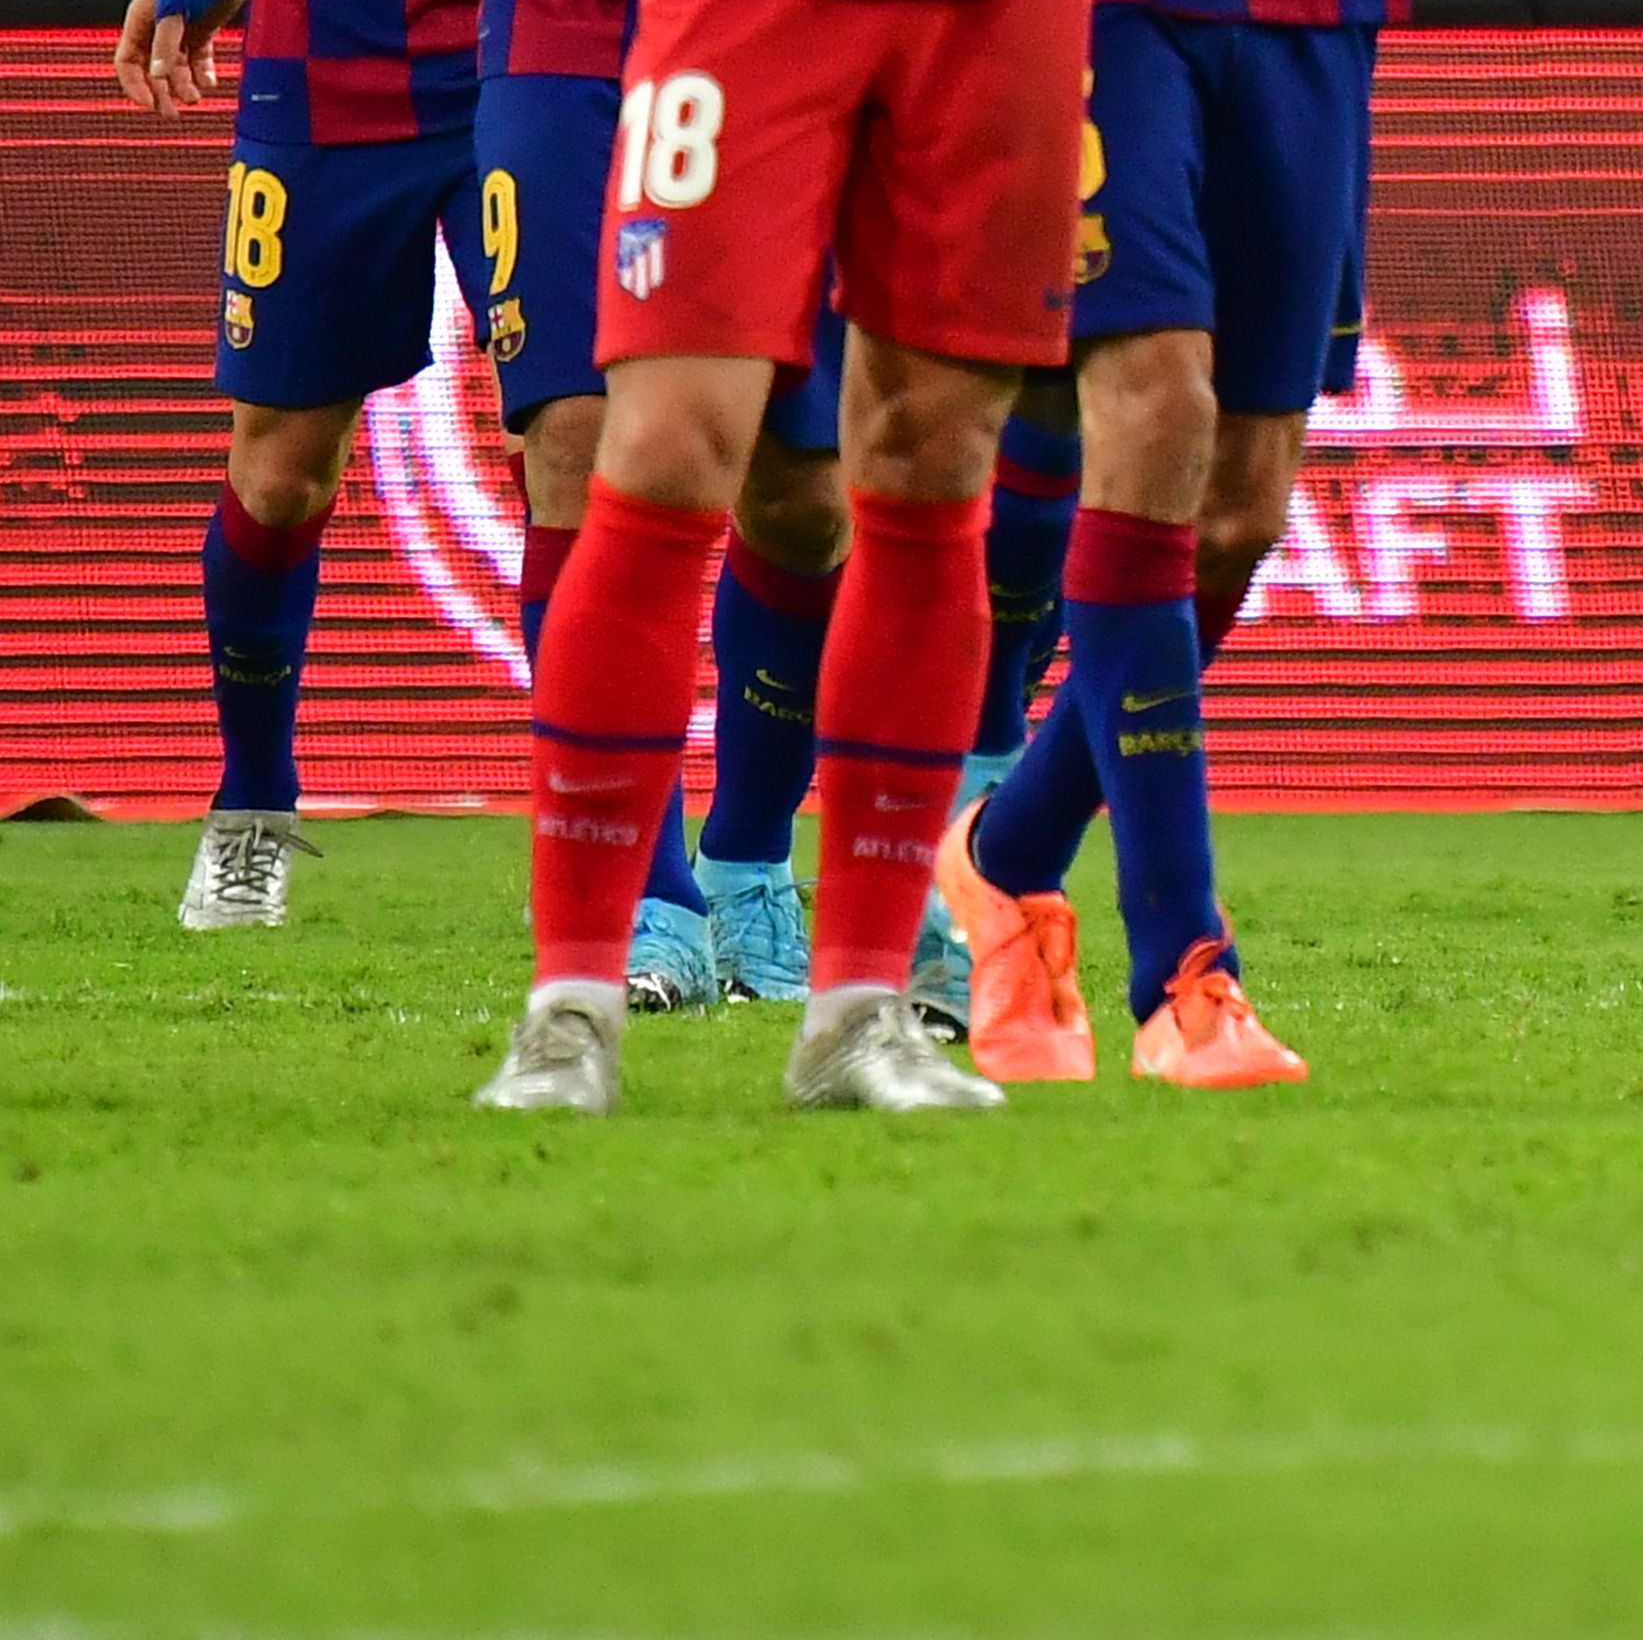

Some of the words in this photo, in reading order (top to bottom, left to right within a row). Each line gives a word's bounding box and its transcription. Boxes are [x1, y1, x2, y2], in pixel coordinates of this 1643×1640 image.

[617, 70, 724, 211] 18
[225, 160, 288, 289] 18
[482, 169, 518, 296] 9
[1240, 475, 1600, 622] AFT
